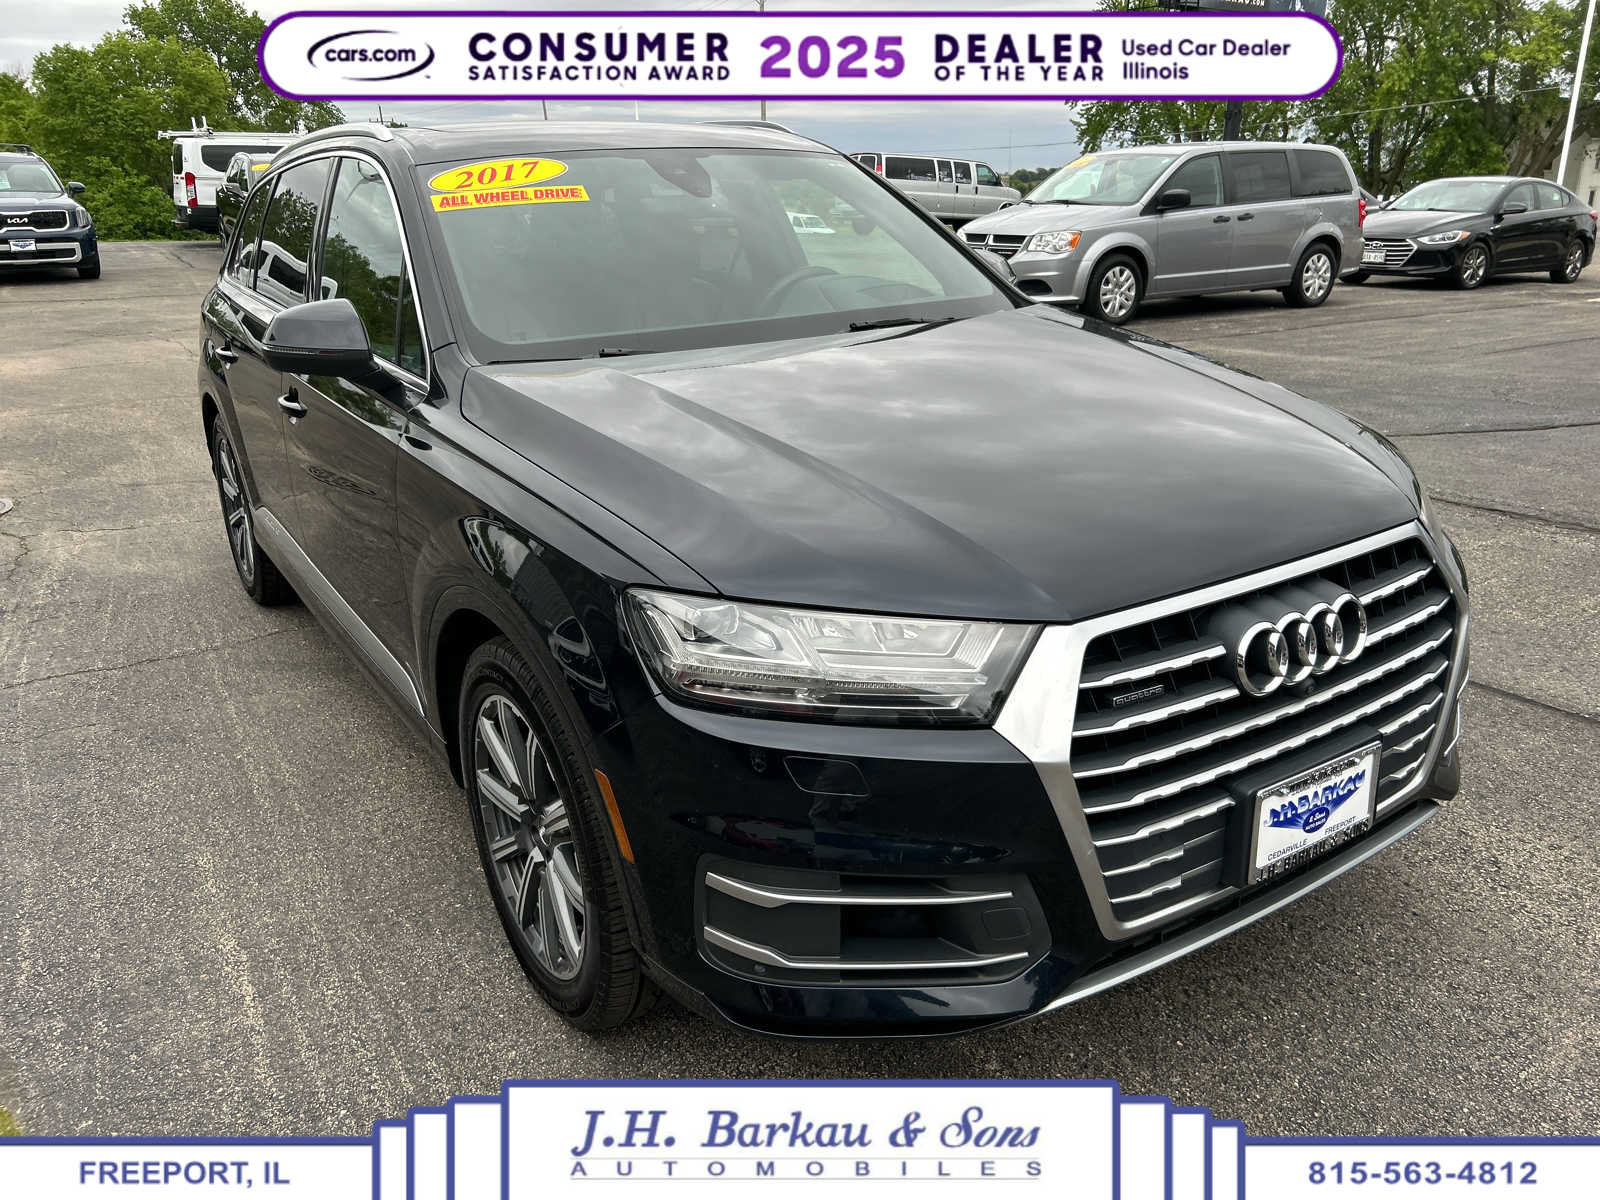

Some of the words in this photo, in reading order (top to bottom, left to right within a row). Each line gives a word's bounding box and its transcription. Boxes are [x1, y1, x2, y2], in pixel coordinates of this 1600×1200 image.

[454, 161, 540, 190] 2017
[439, 194, 471, 208] ALL
[474, 190, 530, 204] WHEEL
[533, 187, 581, 200] DRIVE
[1116, 687, 1163, 705] quattro
[1325, 815, 1356, 835] FREEPORT
[1267, 839, 1308, 861] CEDARVILLE
